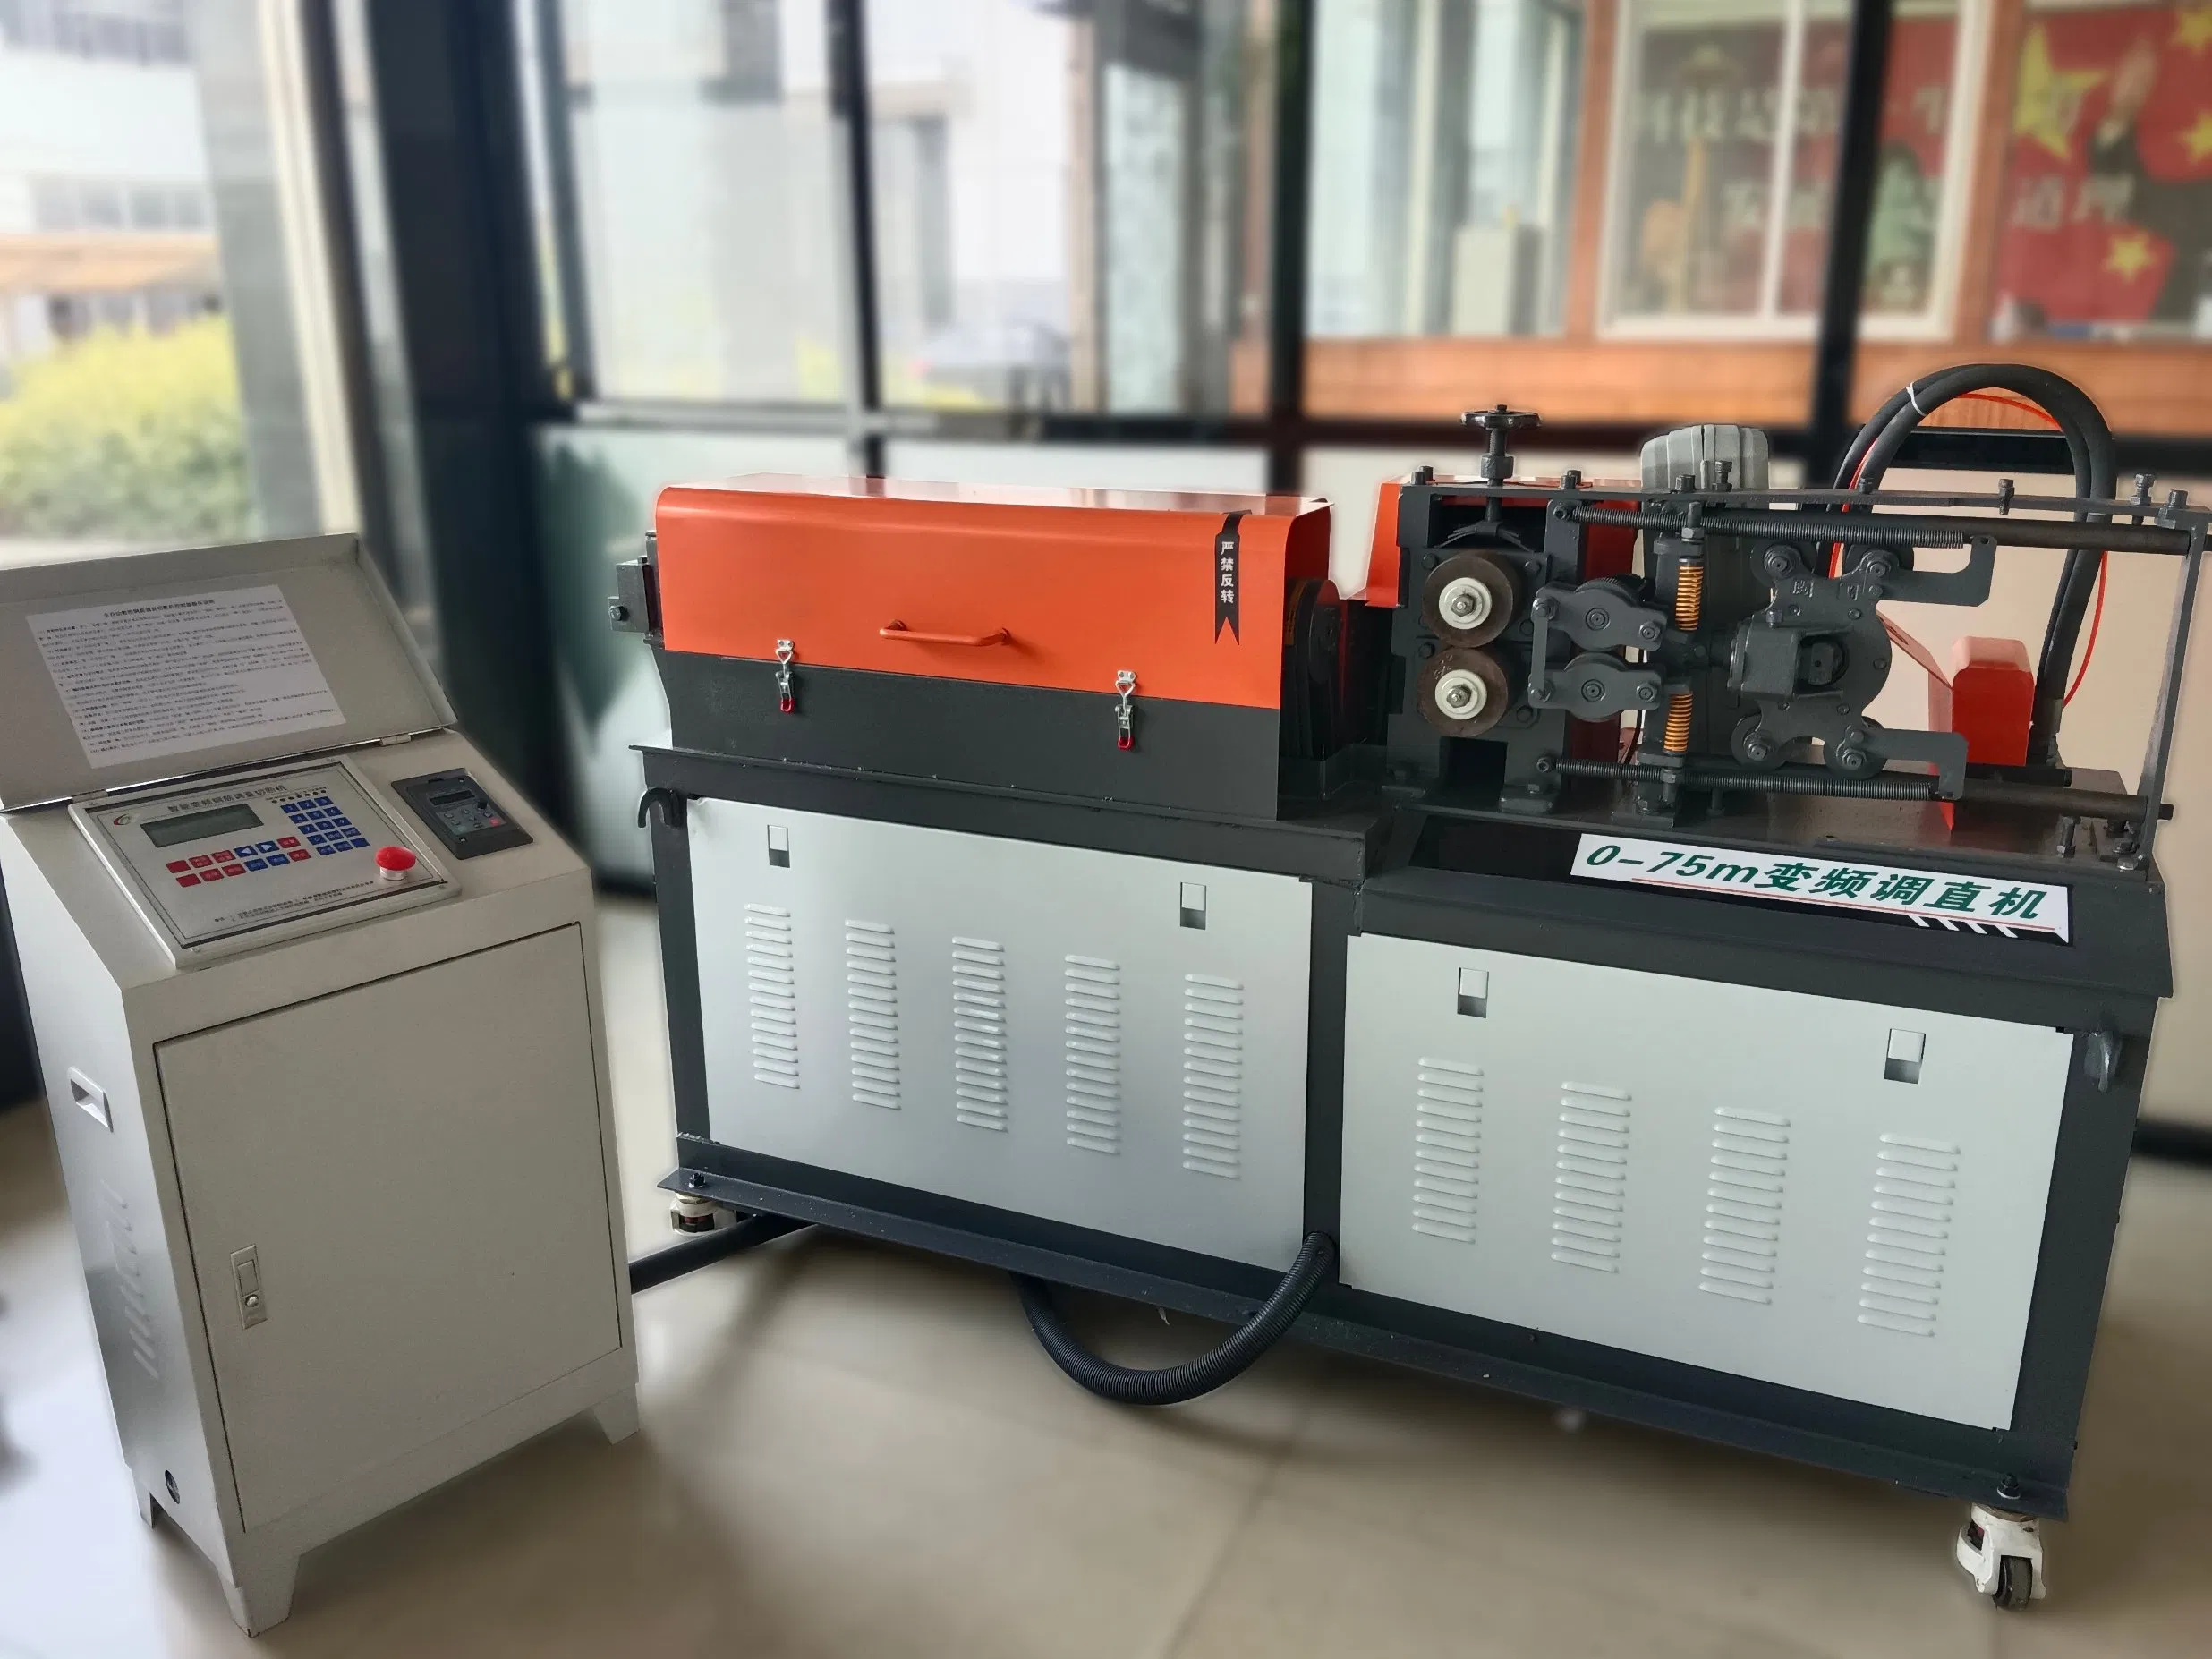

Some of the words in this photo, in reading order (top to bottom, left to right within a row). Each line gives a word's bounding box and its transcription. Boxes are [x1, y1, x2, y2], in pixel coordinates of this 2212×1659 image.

[1221, 541, 1235, 604] 严禁反转
[1586, 844, 2047, 921] 0-75m变频调直机
